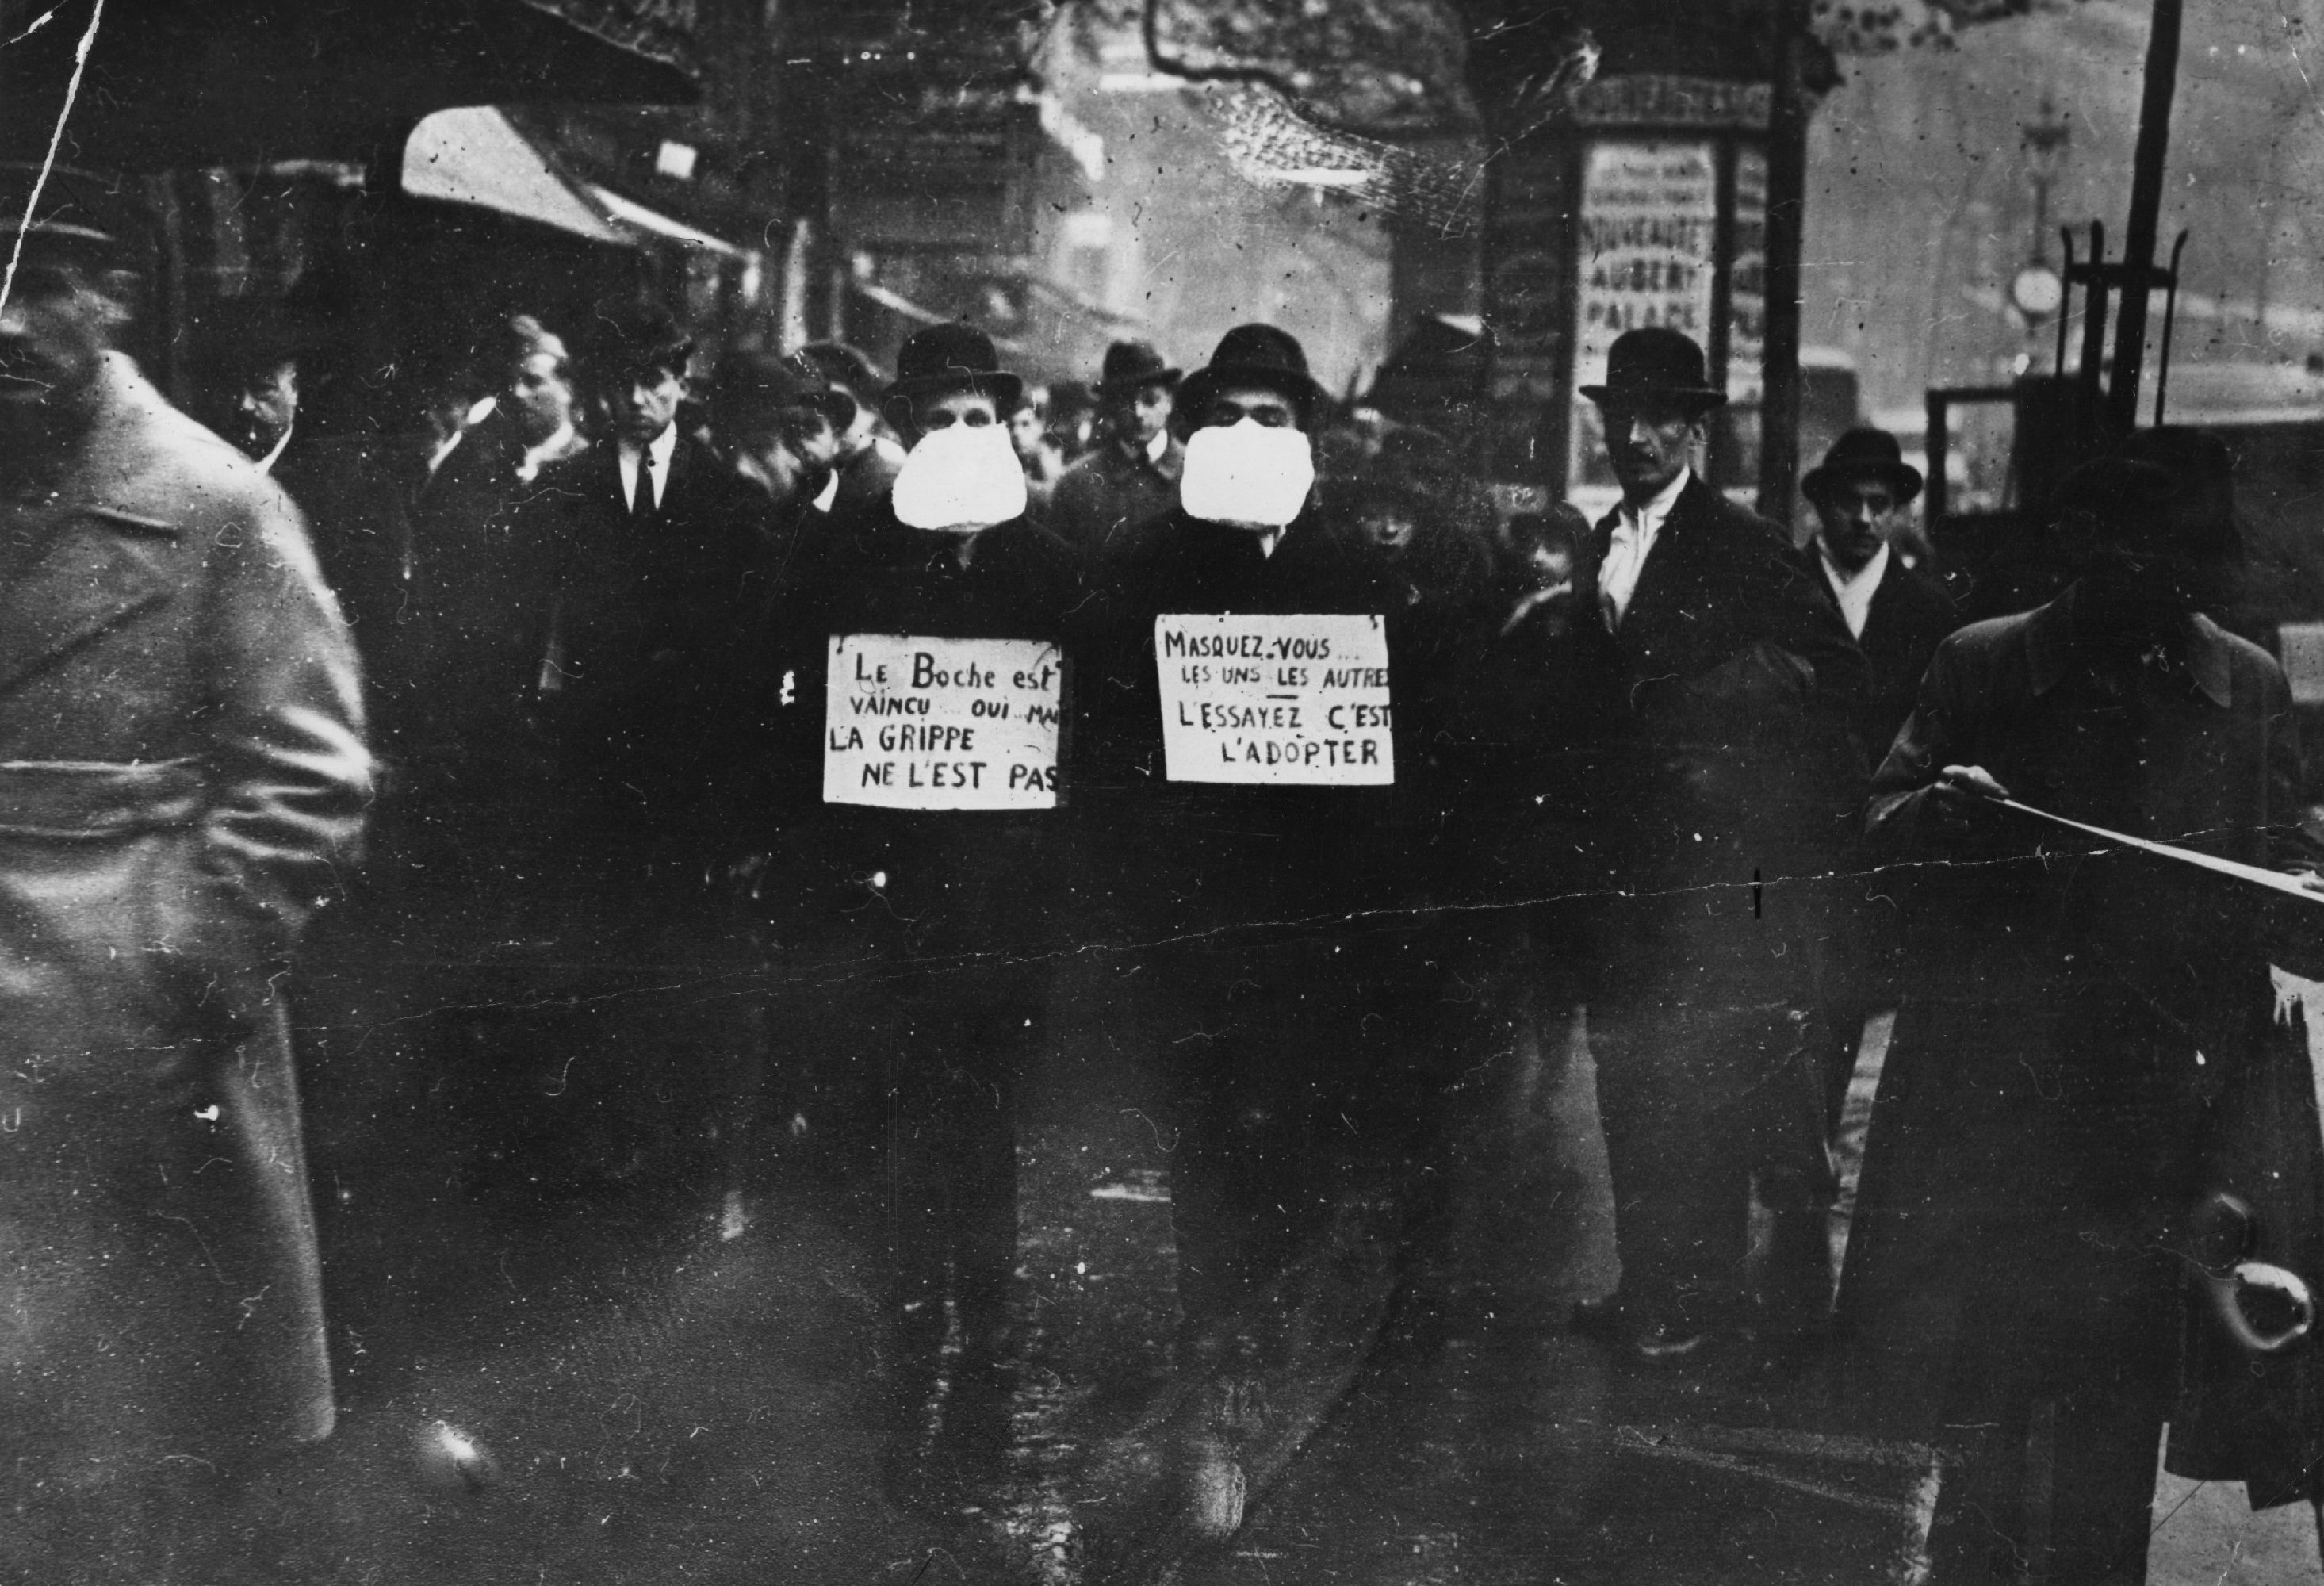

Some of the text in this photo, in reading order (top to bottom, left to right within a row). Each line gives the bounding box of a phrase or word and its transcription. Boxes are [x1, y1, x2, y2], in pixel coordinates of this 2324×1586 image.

[912, 652, 997, 689] Boche
[1013, 665, 1055, 691] est
[1181, 665, 1211, 684] LES
[1223, 666, 1261, 684] UNS
[1277, 667, 1308, 686] LES
[1328, 703, 1390, 730] C'EST
[829, 724, 975, 753] LA GRIPPE
[1222, 737, 1378, 767] L'ADOPTER
[862, 759, 1059, 792] NE L'EST PAS
